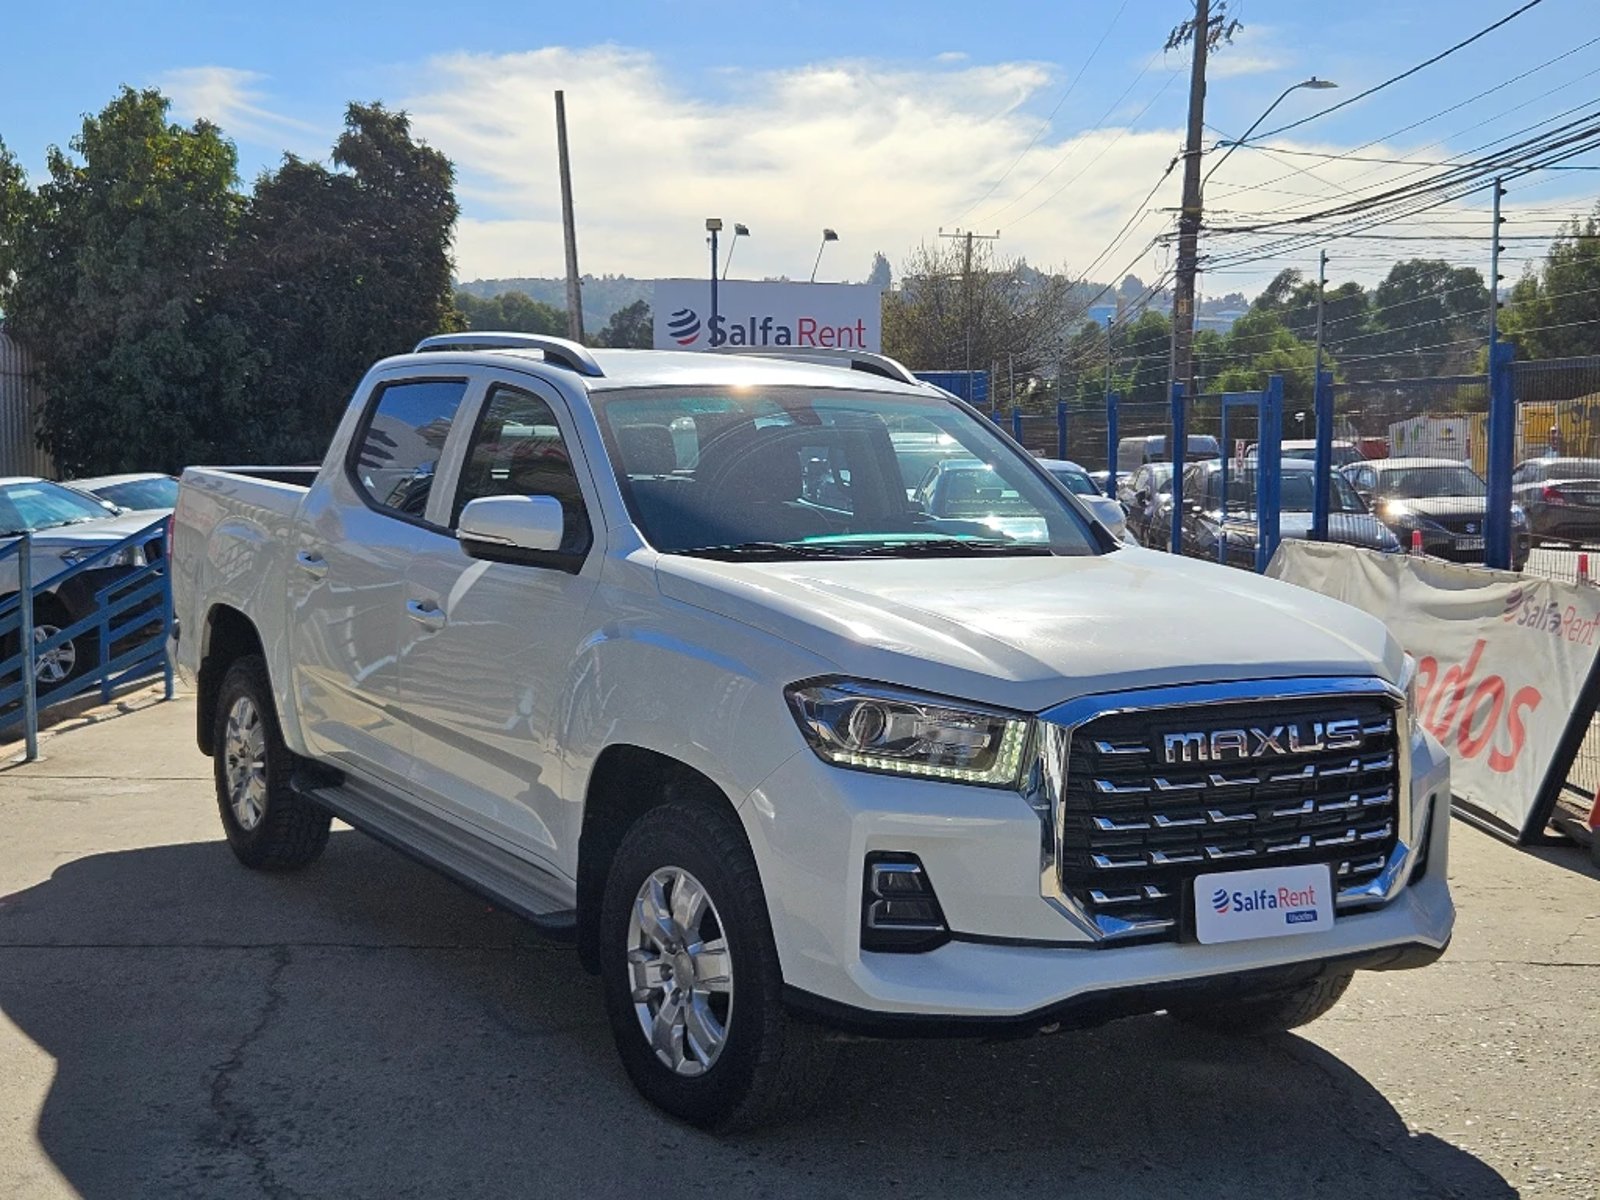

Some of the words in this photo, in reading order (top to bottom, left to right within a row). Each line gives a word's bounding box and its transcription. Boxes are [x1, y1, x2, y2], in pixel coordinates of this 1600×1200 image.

[707, 316, 867, 348] SalfaRent
[1517, 594, 1600, 646] SalfaRent
[1163, 719, 1361, 763] MAXUS
[1232, 885, 1317, 912] SalfaRent
